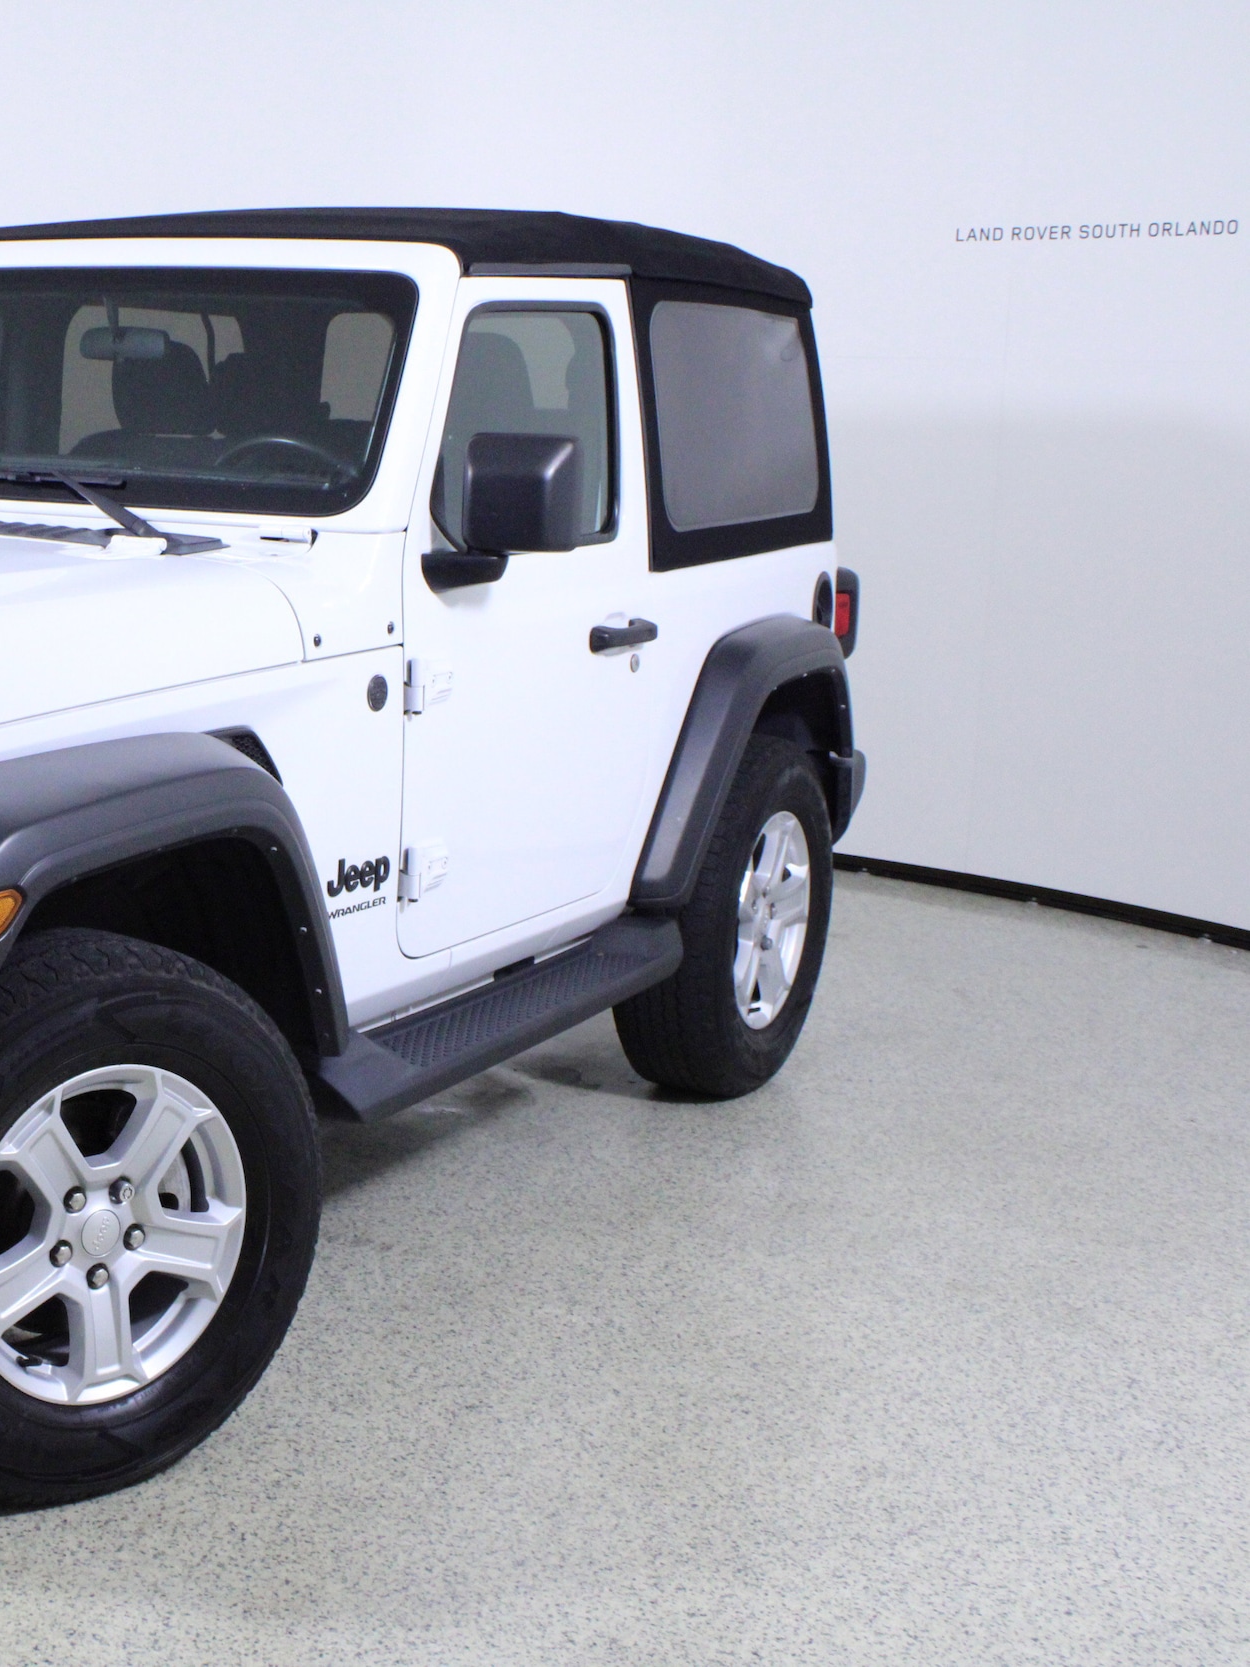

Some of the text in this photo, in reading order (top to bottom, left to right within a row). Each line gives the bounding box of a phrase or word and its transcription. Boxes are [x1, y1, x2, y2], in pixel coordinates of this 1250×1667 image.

[954, 218, 1240, 243] LAND ROVER SOUTH ORLANDO
[327, 856, 390, 897] Jeep
[329, 896, 387, 919] WRANGLER
